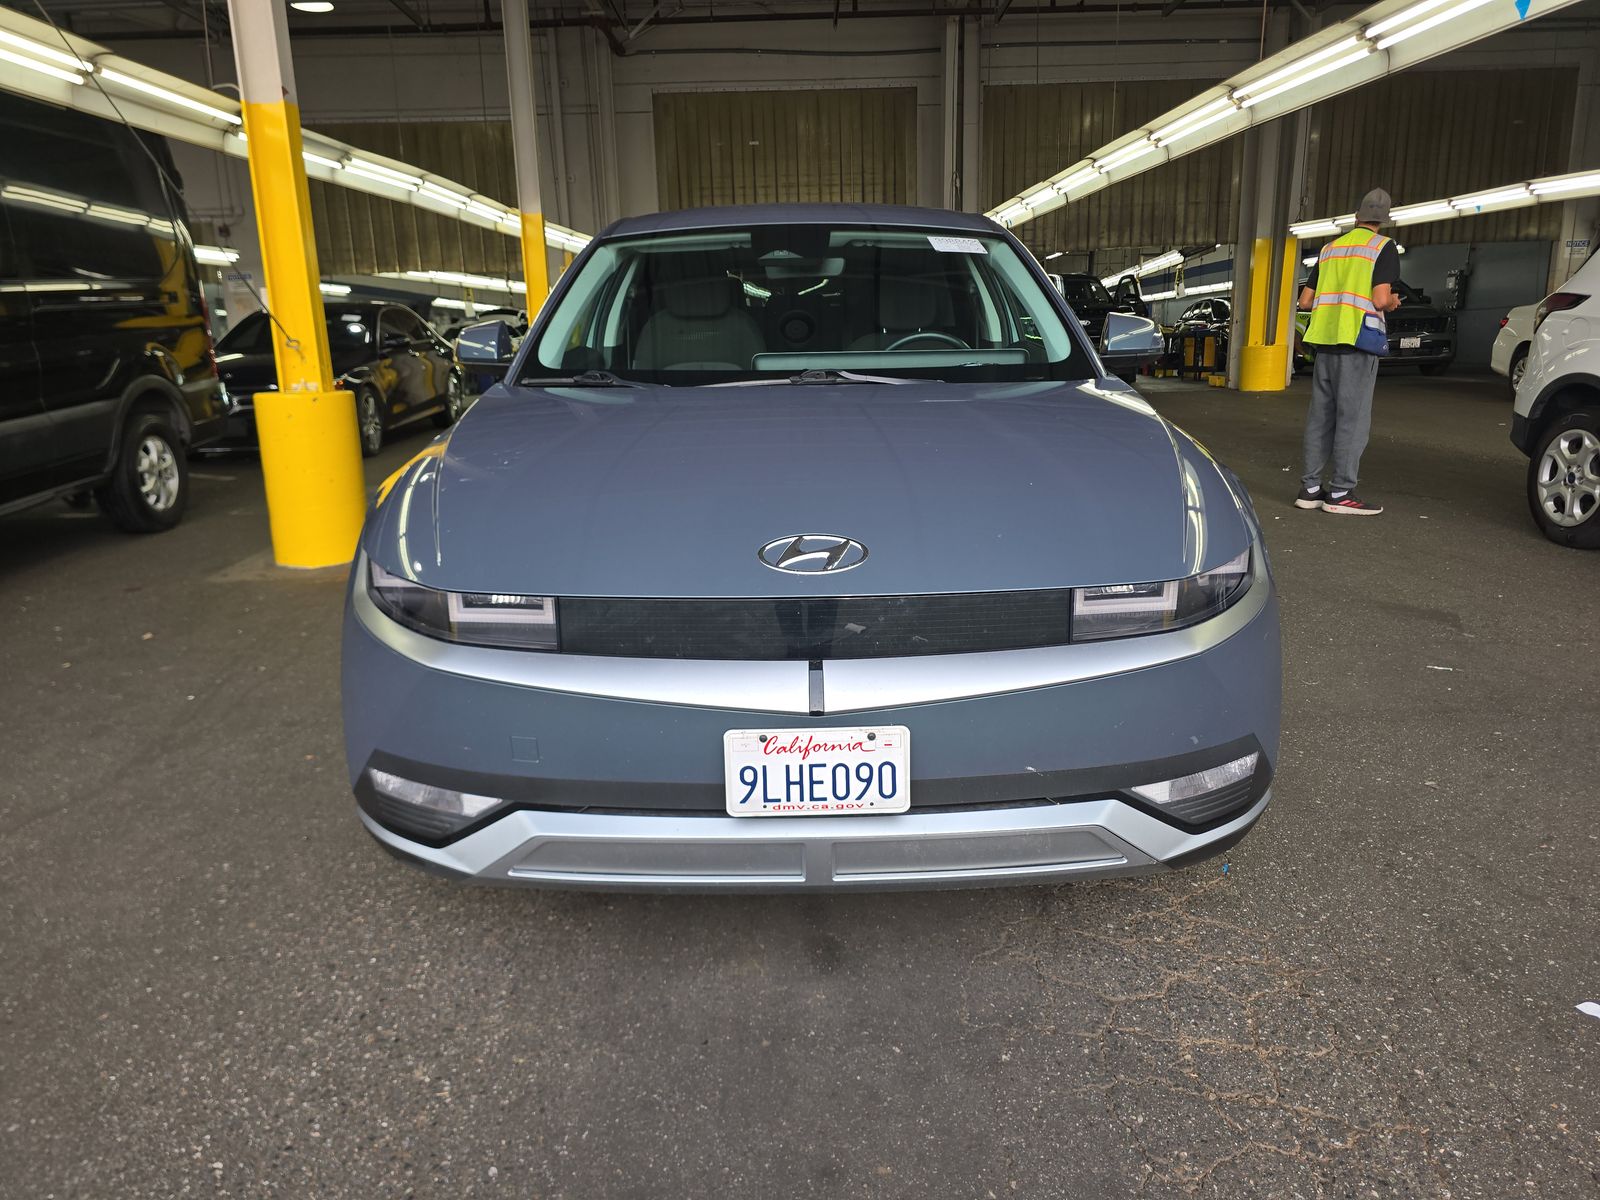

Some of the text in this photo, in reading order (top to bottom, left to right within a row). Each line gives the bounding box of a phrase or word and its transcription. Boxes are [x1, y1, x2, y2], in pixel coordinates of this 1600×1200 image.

[763, 735, 876, 760] California
[739, 761, 897, 804] 9LHE090
[772, 803, 864, 811] dmv.ca.gov
